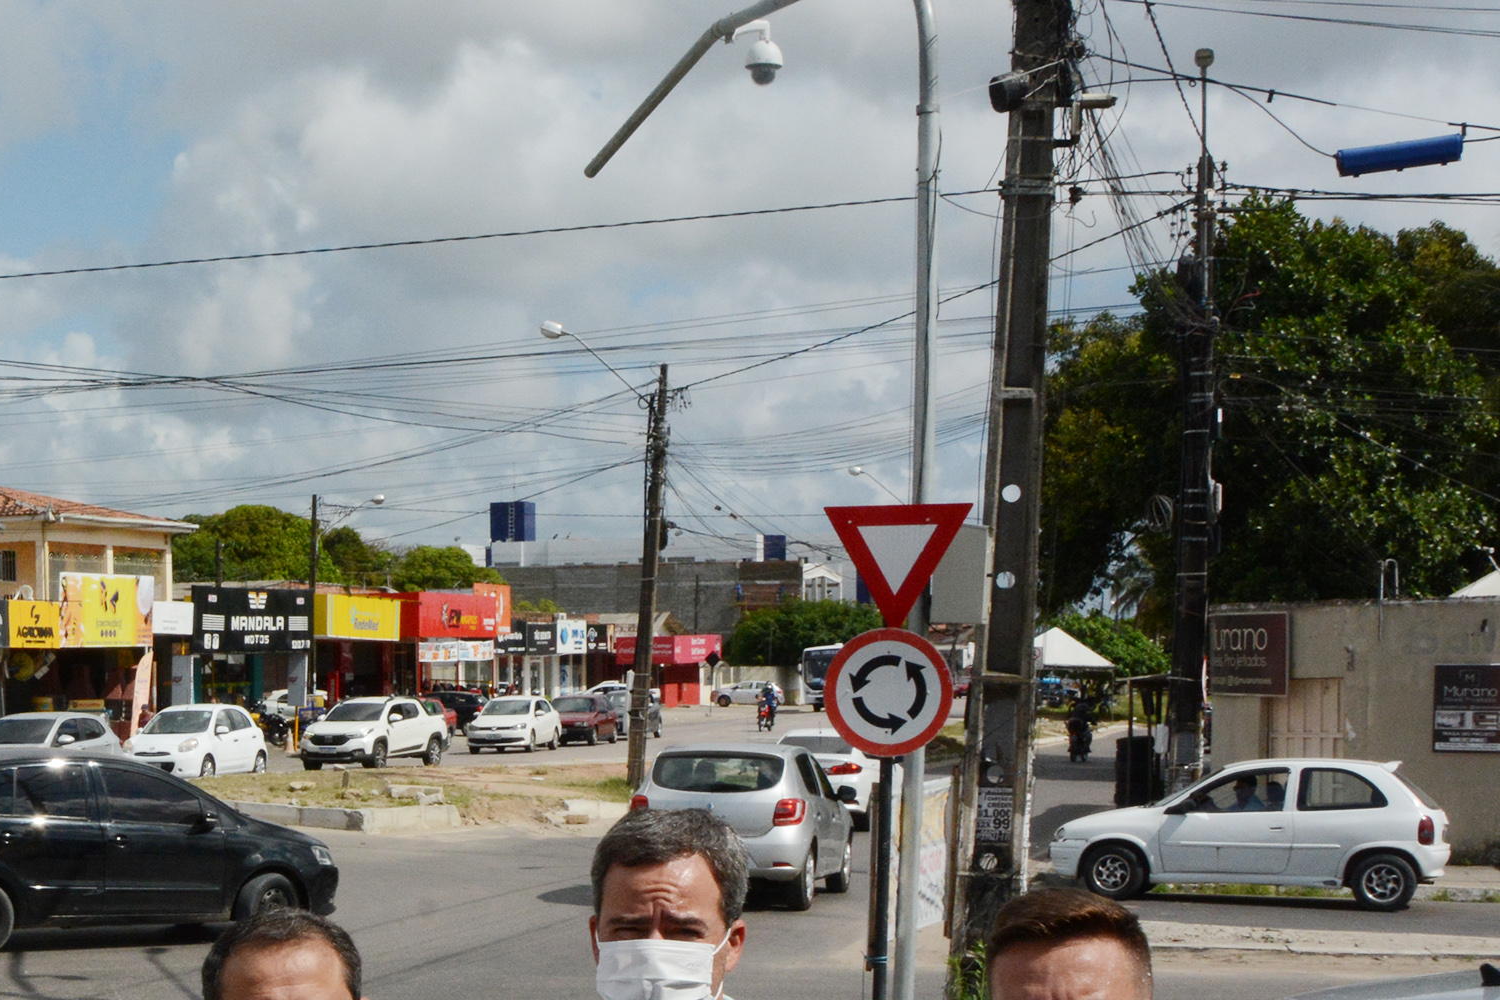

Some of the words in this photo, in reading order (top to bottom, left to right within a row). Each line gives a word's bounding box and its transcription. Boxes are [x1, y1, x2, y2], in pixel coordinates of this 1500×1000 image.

[231, 616, 284, 631] MANDALA
[244, 635, 270, 645] MOTOS
[1214, 627, 1268, 651] urano
[1443, 685, 1498, 697] Murano
[992, 818, 1010, 829] 99
